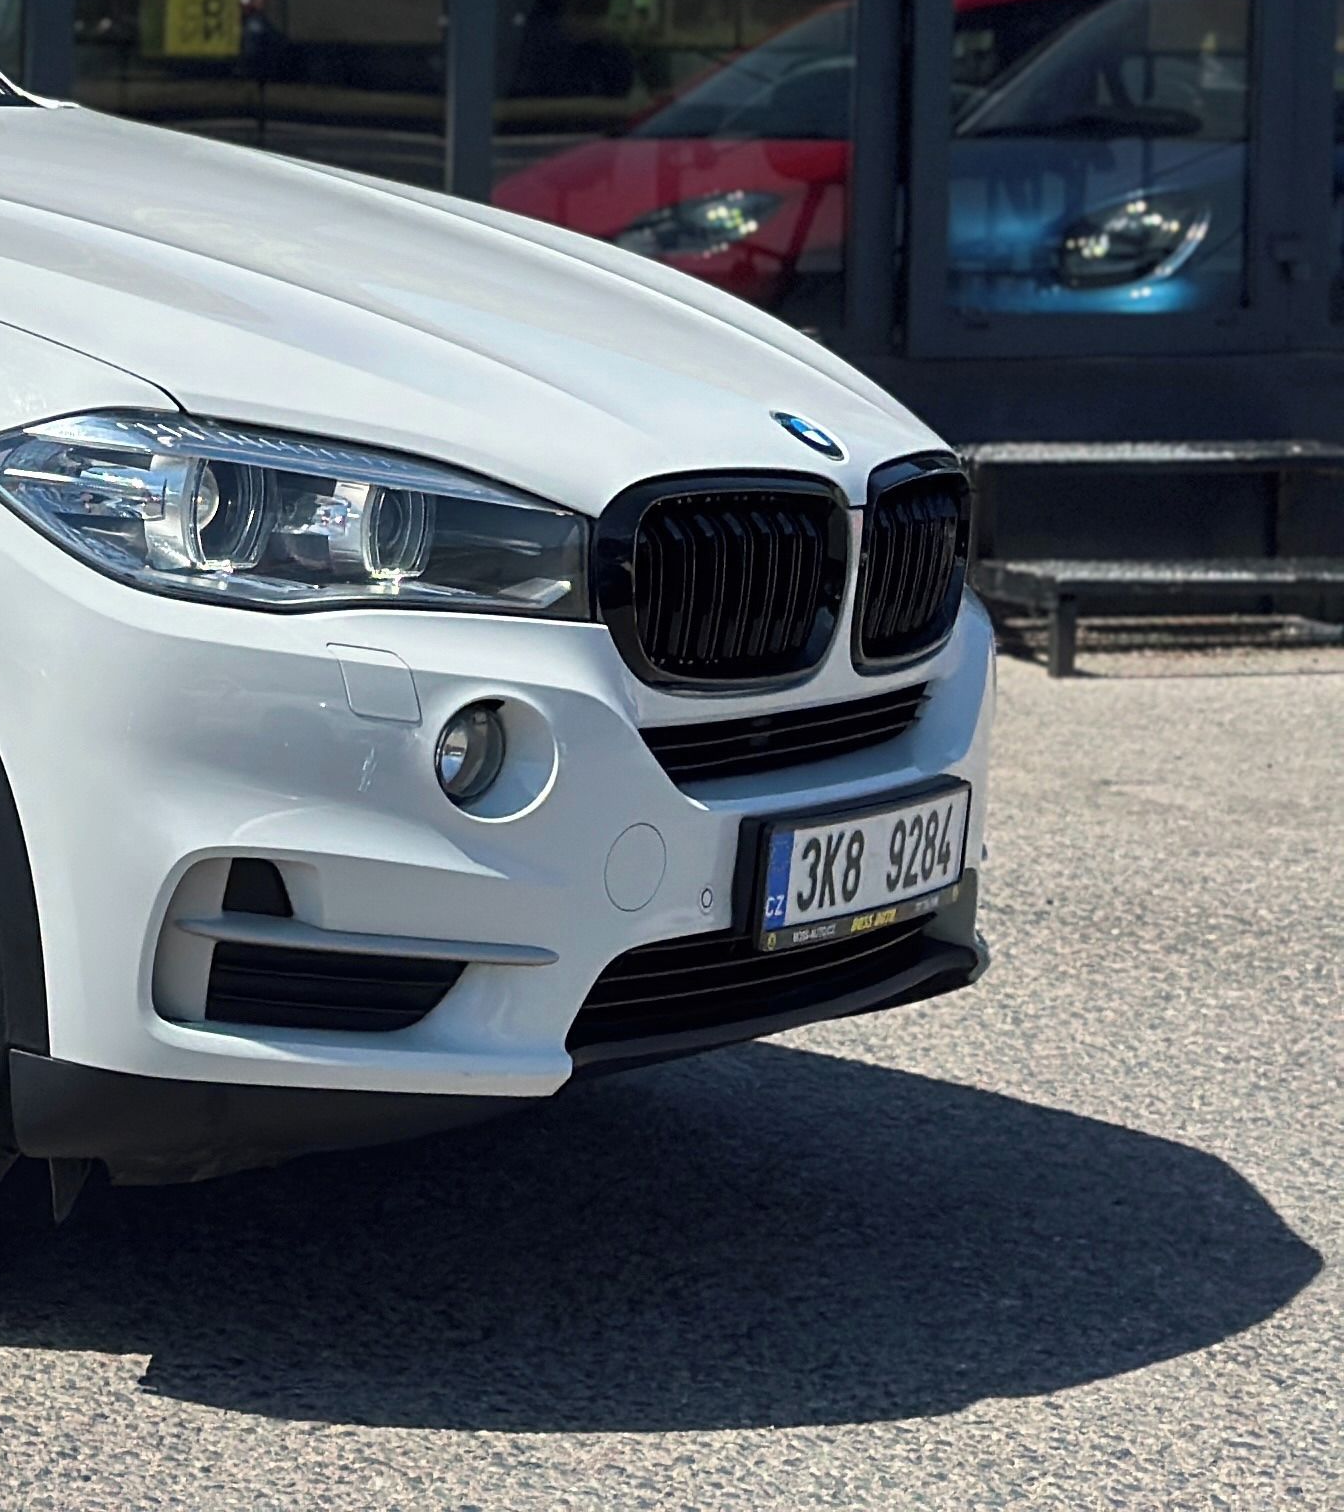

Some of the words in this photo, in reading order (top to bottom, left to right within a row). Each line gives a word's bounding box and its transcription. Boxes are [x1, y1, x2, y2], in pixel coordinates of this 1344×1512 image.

[796, 830, 865, 912] 3K8
[885, 801, 954, 893] 9284
[764, 895, 785, 918] CZ
